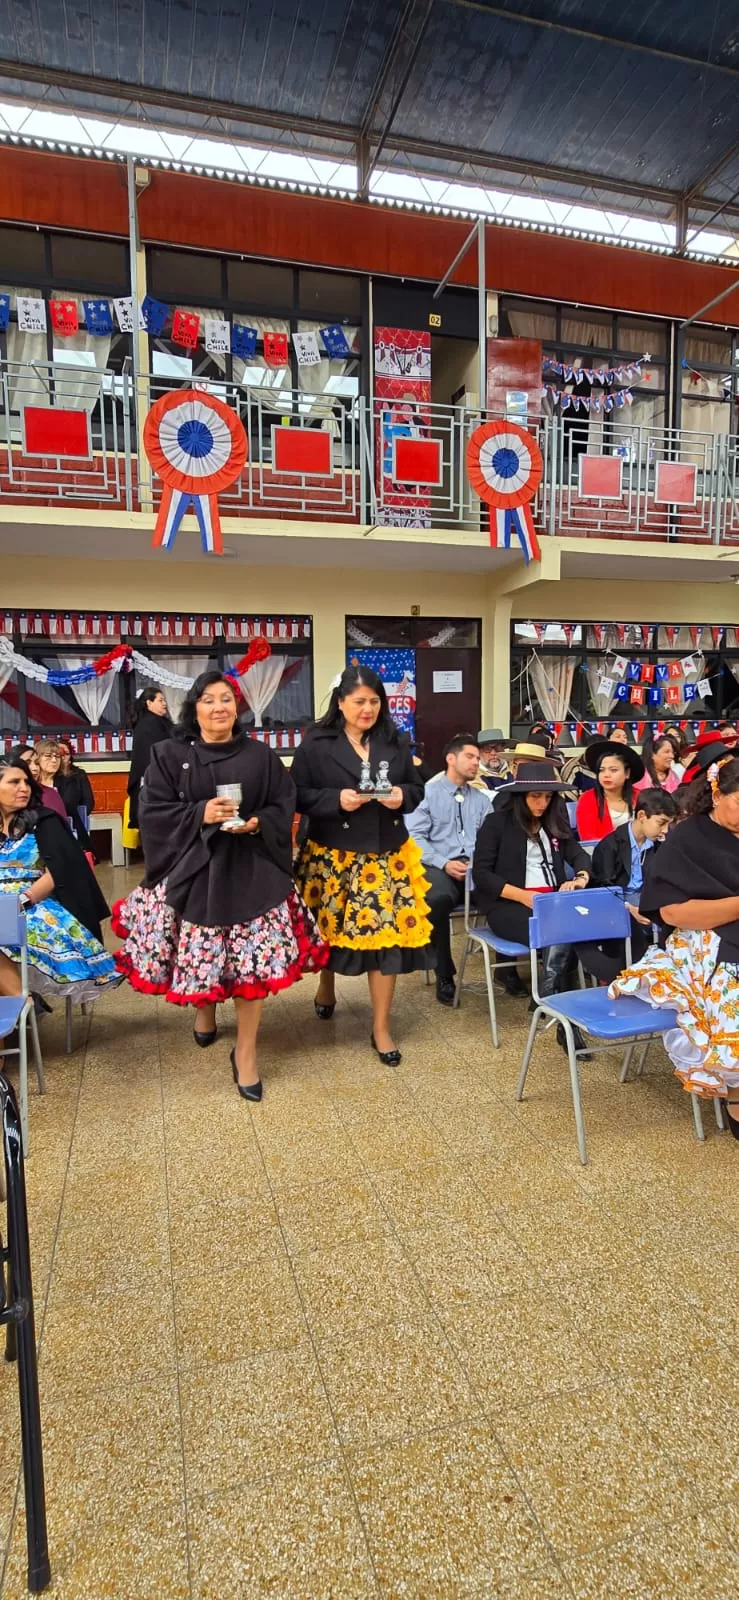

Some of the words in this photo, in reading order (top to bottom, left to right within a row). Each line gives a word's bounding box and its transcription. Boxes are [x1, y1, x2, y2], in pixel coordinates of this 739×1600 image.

[430, 315, 441, 325] 02
[20, 322, 46, 331] CHILE
[206, 343, 229, 351] CHILE
[298, 355, 320, 364] CHILE
[630, 661, 681, 679] VIVA
[617, 685, 694, 701] CHILE
